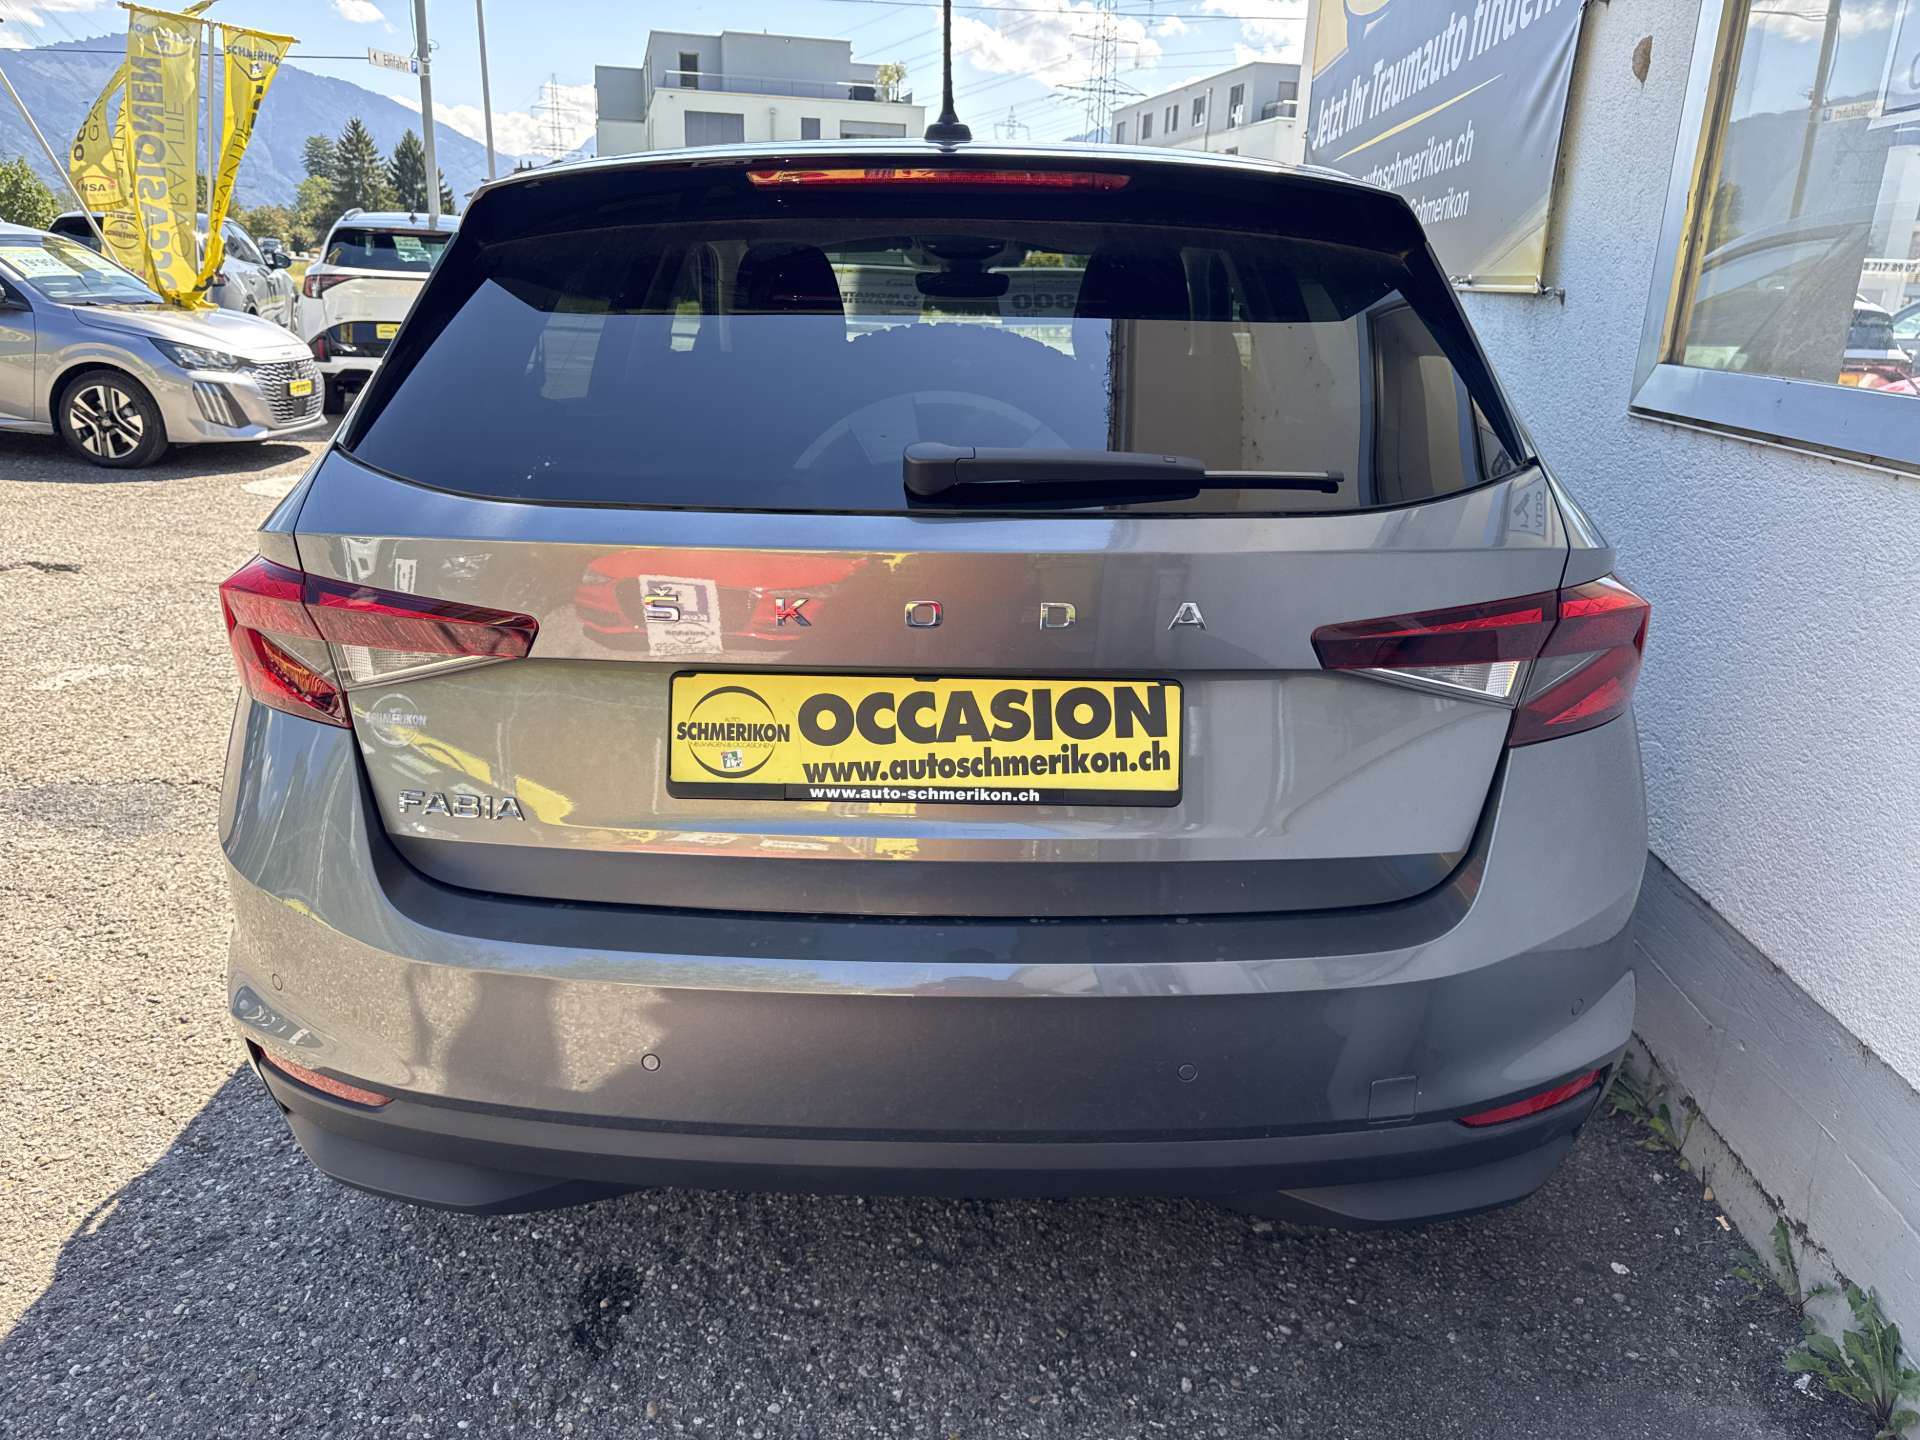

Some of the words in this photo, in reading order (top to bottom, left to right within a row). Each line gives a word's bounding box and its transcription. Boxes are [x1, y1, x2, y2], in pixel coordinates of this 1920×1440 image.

[1311, 88, 1348, 151] Jetzt
[1345, 74, 1371, 133] Ihr
[1369, 11, 1468, 119] Traumauto
[676, 721, 791, 743] SCHMERIKON
[797, 684, 1170, 748] OCCASION
[802, 740, 1171, 784] www.autoschmerikon.ch
[398, 788, 526, 822] FABIA
[809, 787, 1041, 804] www.auto-schmerikon.ch
